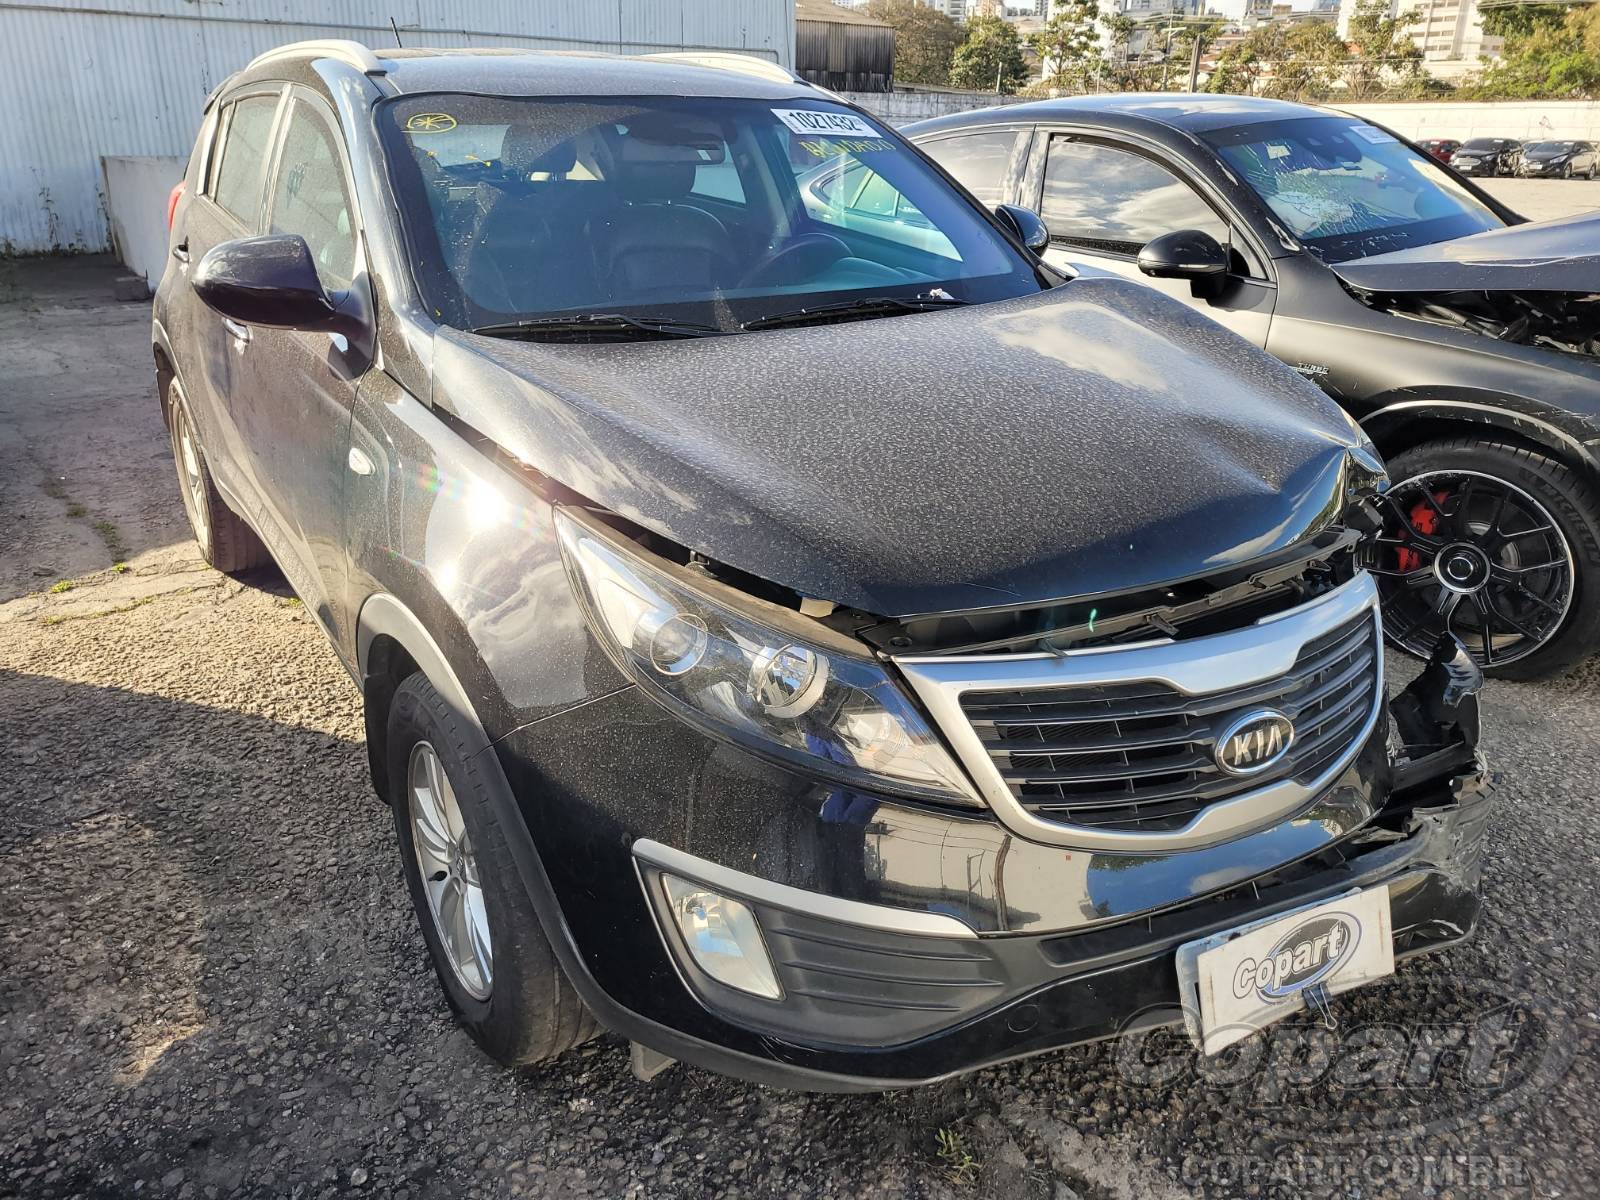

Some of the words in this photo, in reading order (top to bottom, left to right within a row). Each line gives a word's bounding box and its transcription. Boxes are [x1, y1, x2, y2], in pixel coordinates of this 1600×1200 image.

[789, 112, 863, 131] 1027432
[1233, 724, 1283, 766] KIA
[1232, 919, 1347, 999] Copart
